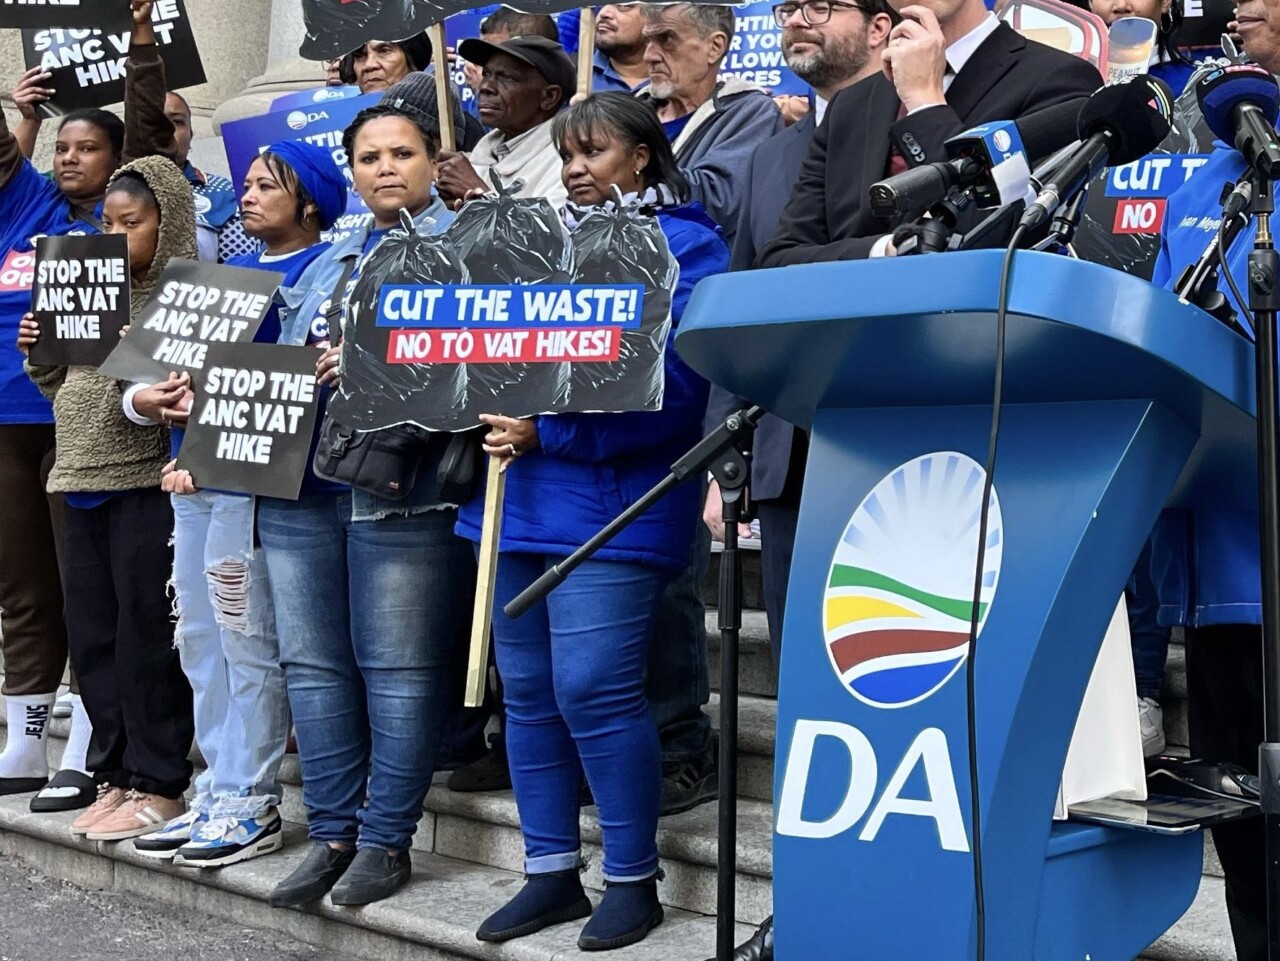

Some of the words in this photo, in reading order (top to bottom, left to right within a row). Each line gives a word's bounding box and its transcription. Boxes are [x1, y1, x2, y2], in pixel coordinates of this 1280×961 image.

[40, 39, 105, 72] ANC
[108, 23, 174, 53] VT
[731, 52, 788, 69] LOW
[75, 57, 128, 87] HIK
[307, 110, 329, 122] DA
[1113, 158, 1170, 190] CUT
[1121, 202, 1157, 229] NO
[37, 260, 81, 284] STOP
[85, 258, 125, 282] THE
[36, 287, 75, 311] ANC
[77, 287, 119, 311] VAT
[158, 281, 221, 310] STOP
[221, 290, 269, 319] THE
[383, 289, 444, 321] CUT
[455, 290, 508, 322] THE
[523, 289, 637, 322] WASTE!
[56, 315, 100, 339] HIKE
[143, 309, 195, 334] ANC
[200, 316, 249, 342] VAT
[152, 338, 208, 369] HIKE
[395, 333, 431, 358] NO
[441, 333, 474, 358] TO
[484, 332, 527, 357] VAT
[536, 330, 612, 357] HIKES!
[204, 367, 265, 397] STOP
[269, 372, 316, 402] THE
[198, 399, 249, 427] ANC
[253, 403, 304, 433] VAT
[216, 432, 274, 464] HIKE
[25, 704, 49, 739] JEANS
[776, 719, 970, 852] DA
